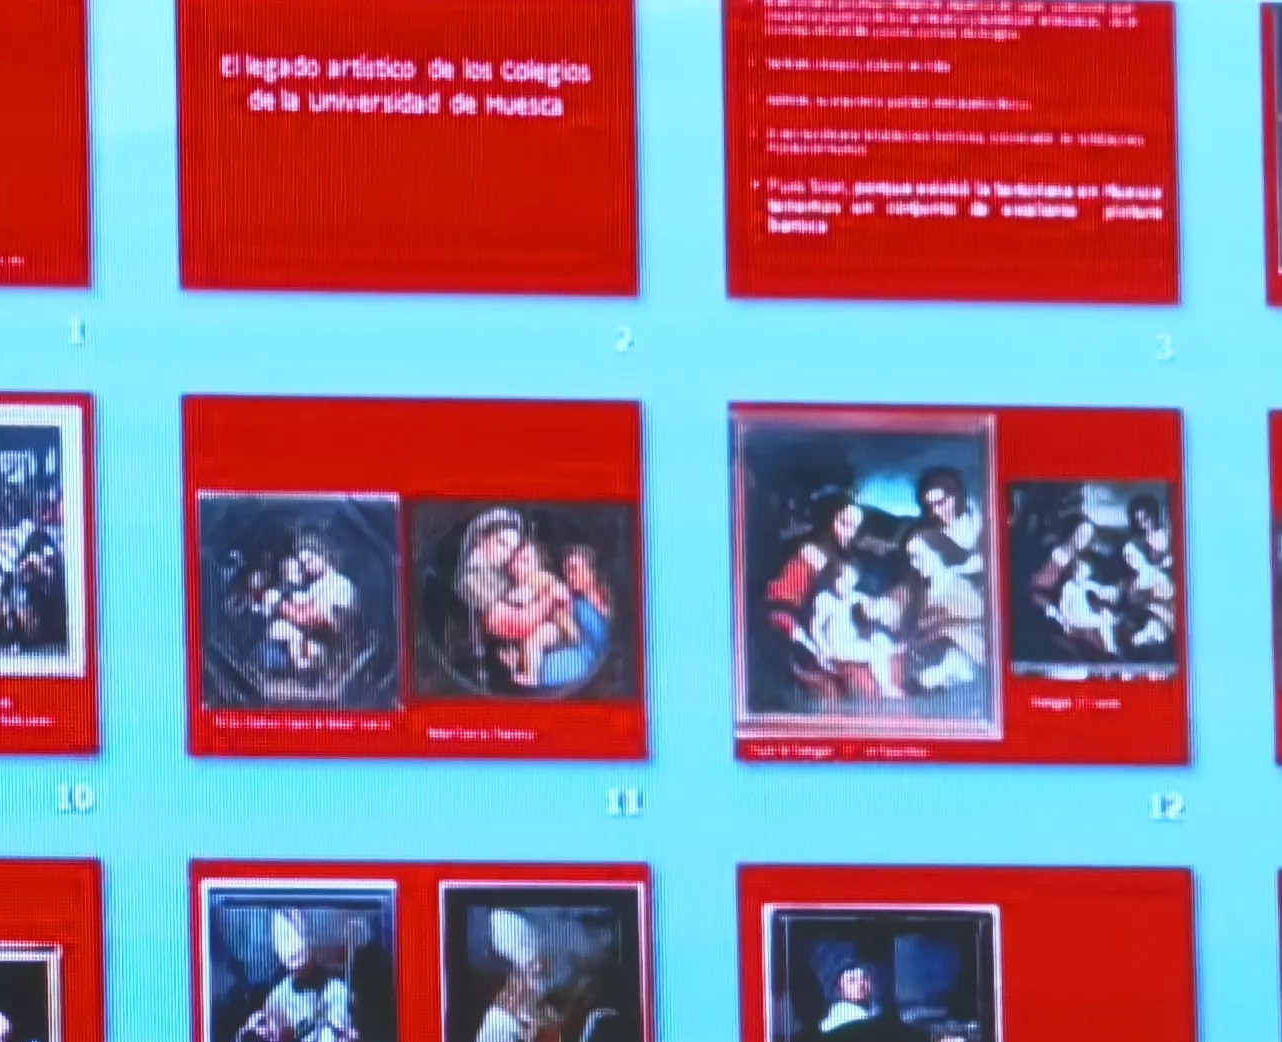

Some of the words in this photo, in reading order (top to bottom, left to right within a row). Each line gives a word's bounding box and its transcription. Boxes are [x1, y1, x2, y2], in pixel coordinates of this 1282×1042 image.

[221, 54, 239, 78] El
[244, 54, 318, 84] legado
[327, 55, 417, 80] artístico
[427, 57, 455, 82] de
[462, 58, 493, 82] los
[247, 89, 276, 112] de
[280, 89, 300, 113] la
[449, 92, 478, 116] de
[485, 95, 564, 117] Huesca
[614, 325, 634, 352] 2
[1155, 333, 1175, 360] 3
[57, 783, 93, 813] 10
[606, 788, 643, 816] 11
[1151, 792, 1186, 820] 12
